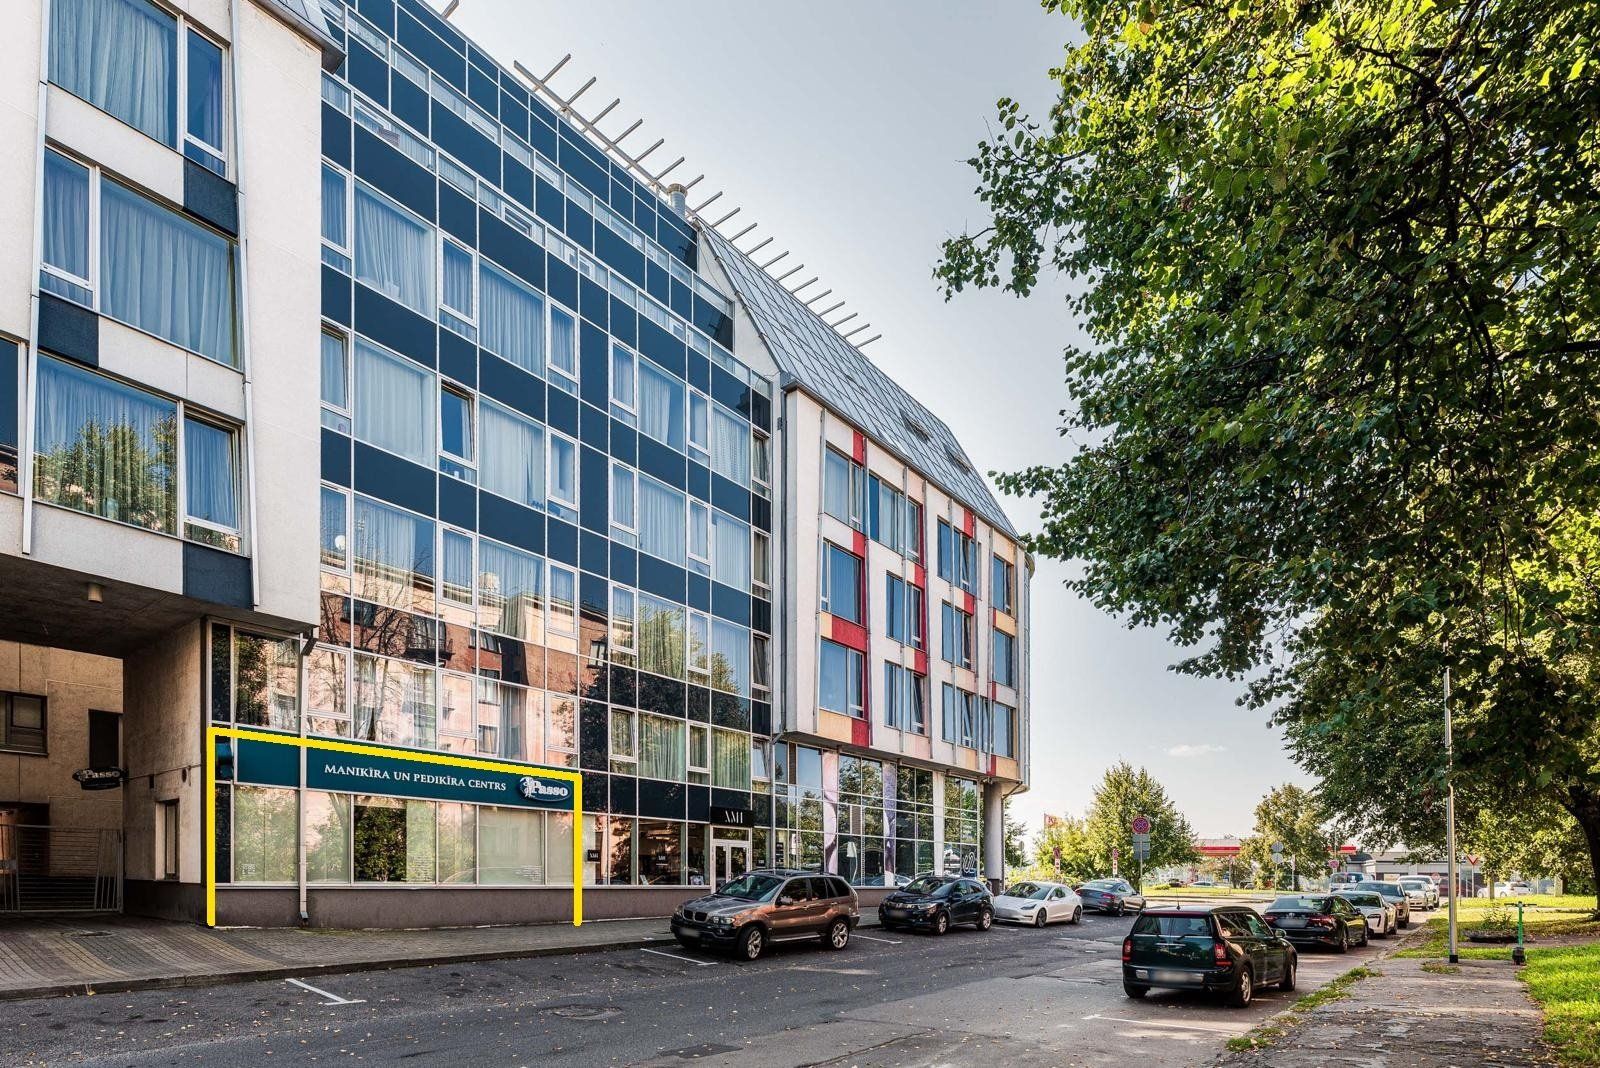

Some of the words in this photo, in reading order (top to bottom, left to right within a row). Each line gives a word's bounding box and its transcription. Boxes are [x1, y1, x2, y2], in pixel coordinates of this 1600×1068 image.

[83, 769, 121, 779] Passo
[324, 764, 390, 779] MANIKĪRA
[393, 771, 410, 781] UN
[413, 773, 466, 787] PEDIKĪRA
[468, 779, 507, 791] CENTRS
[531, 779, 569, 797] Passo
